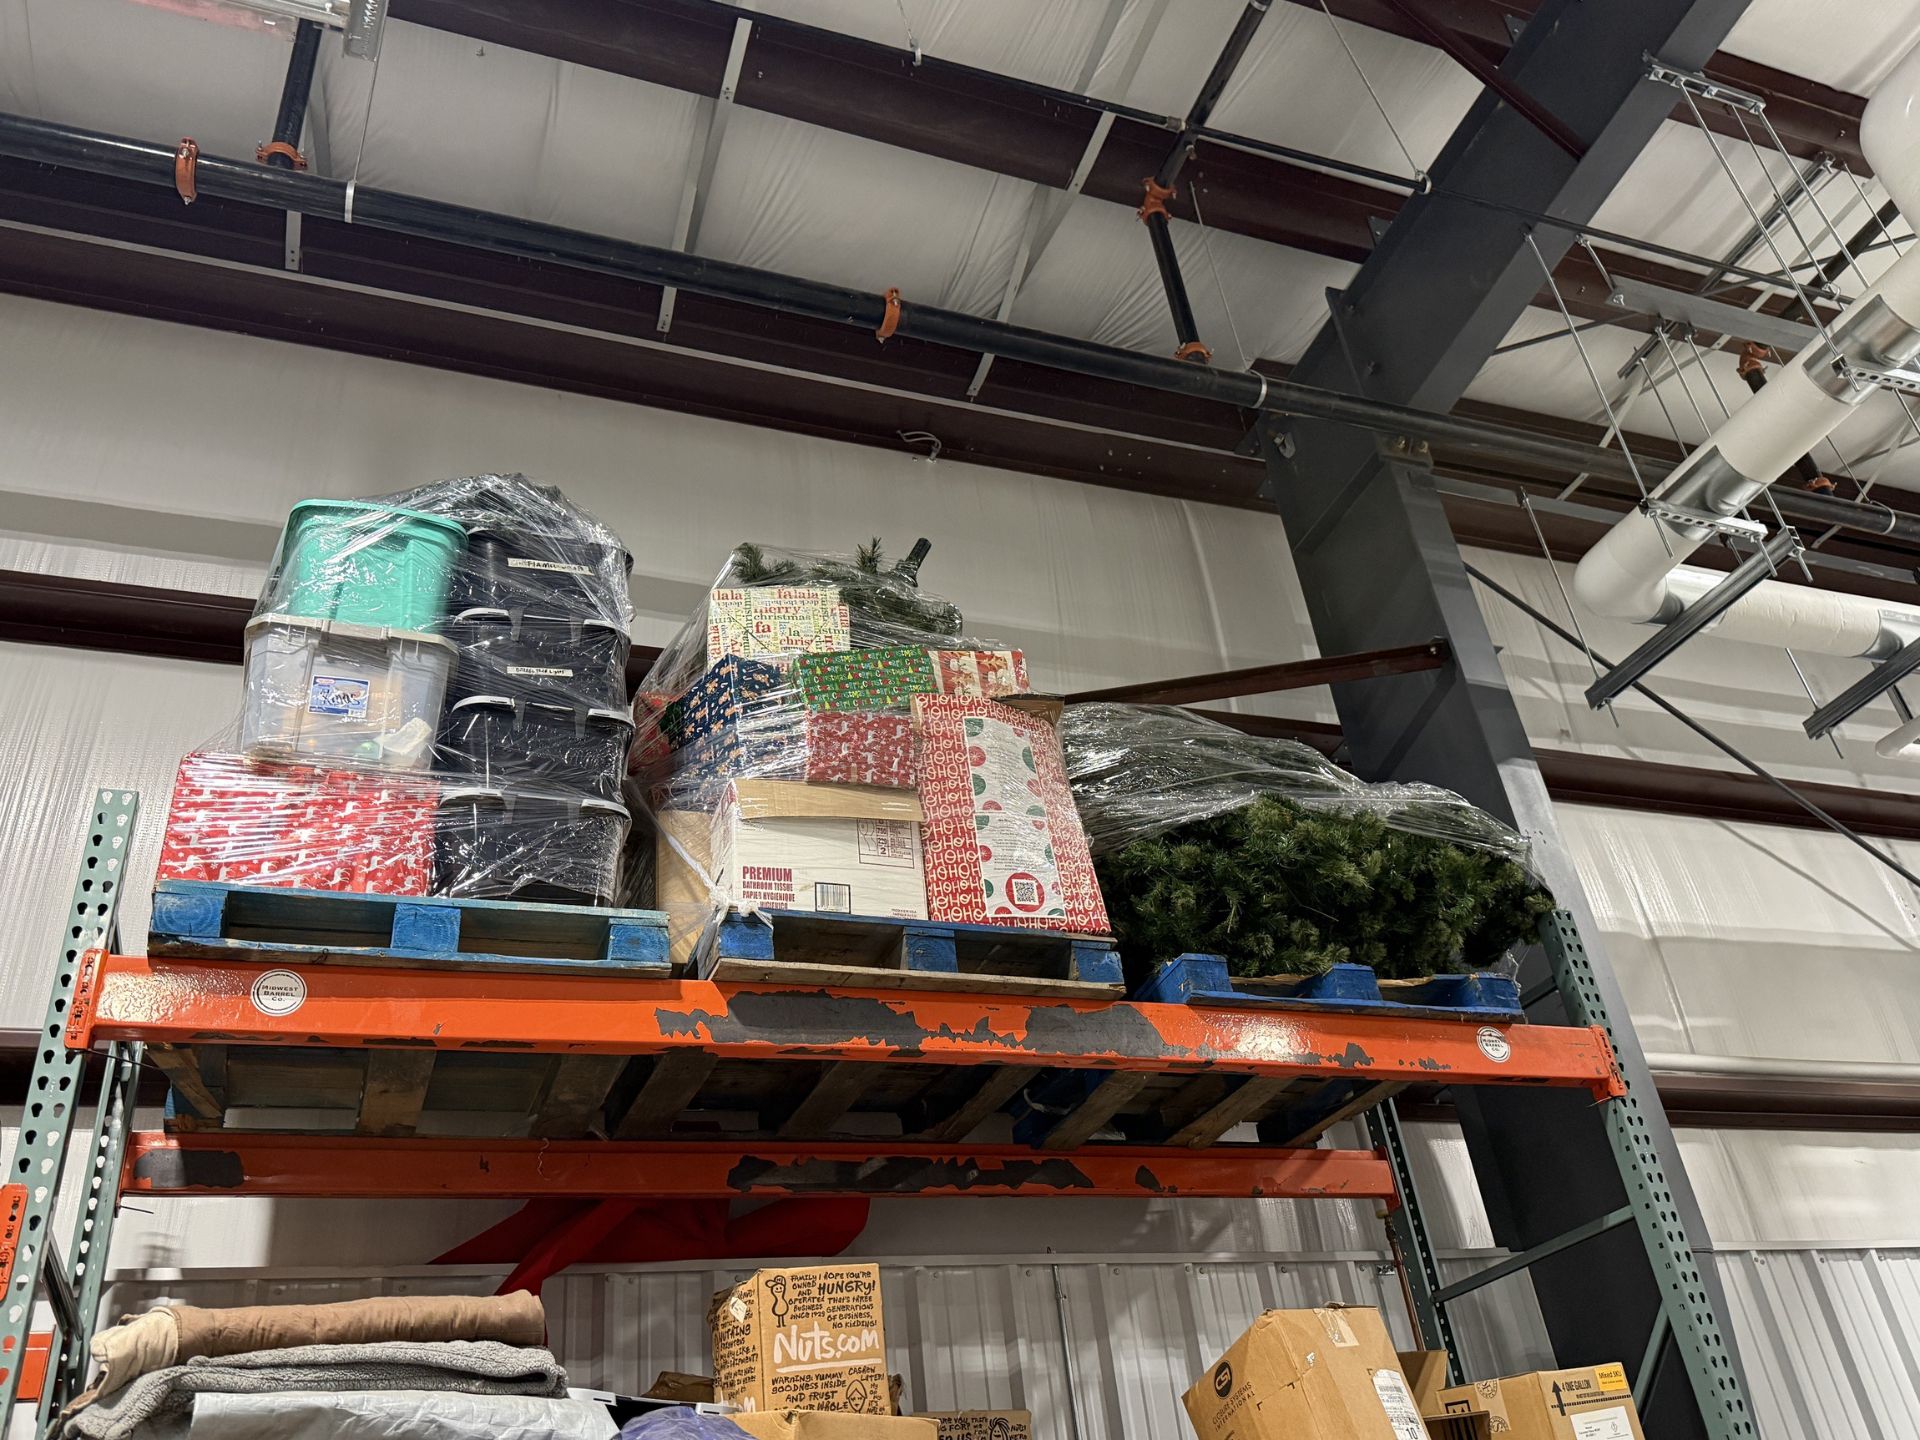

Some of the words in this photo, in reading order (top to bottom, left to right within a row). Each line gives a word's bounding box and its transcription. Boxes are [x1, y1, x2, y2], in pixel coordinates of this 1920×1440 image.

[753, 612, 811, 620] christmas
[755, 620, 772, 634] fa
[788, 627, 800, 637] la
[742, 866, 792, 882] PREMIUM
[742, 881, 773, 890] BATHROOM
[773, 882, 793, 892] TISSUE
[790, 1274, 817, 1283] FAMILY
[817, 1279, 876, 1296] HUNGRY!
[797, 1289, 812, 1298] AND
[793, 1304, 823, 1312] BUSINESS
[826, 1303, 874, 1314] GENERATIONS
[832, 1321, 843, 1330] NO
[844, 1319, 877, 1329] KIDDING!
[814, 1371, 844, 1381] YUMMY
[820, 1380, 847, 1390] INSIDE
[1565, 1380, 1576, 1391] ONE
[1575, 1379, 1592, 1390] GALLON
[785, 1392, 806, 1404] AND
[1230, 1381, 1252, 1404] SYSTEMS
[816, 1401, 849, 1412] WHOLE
